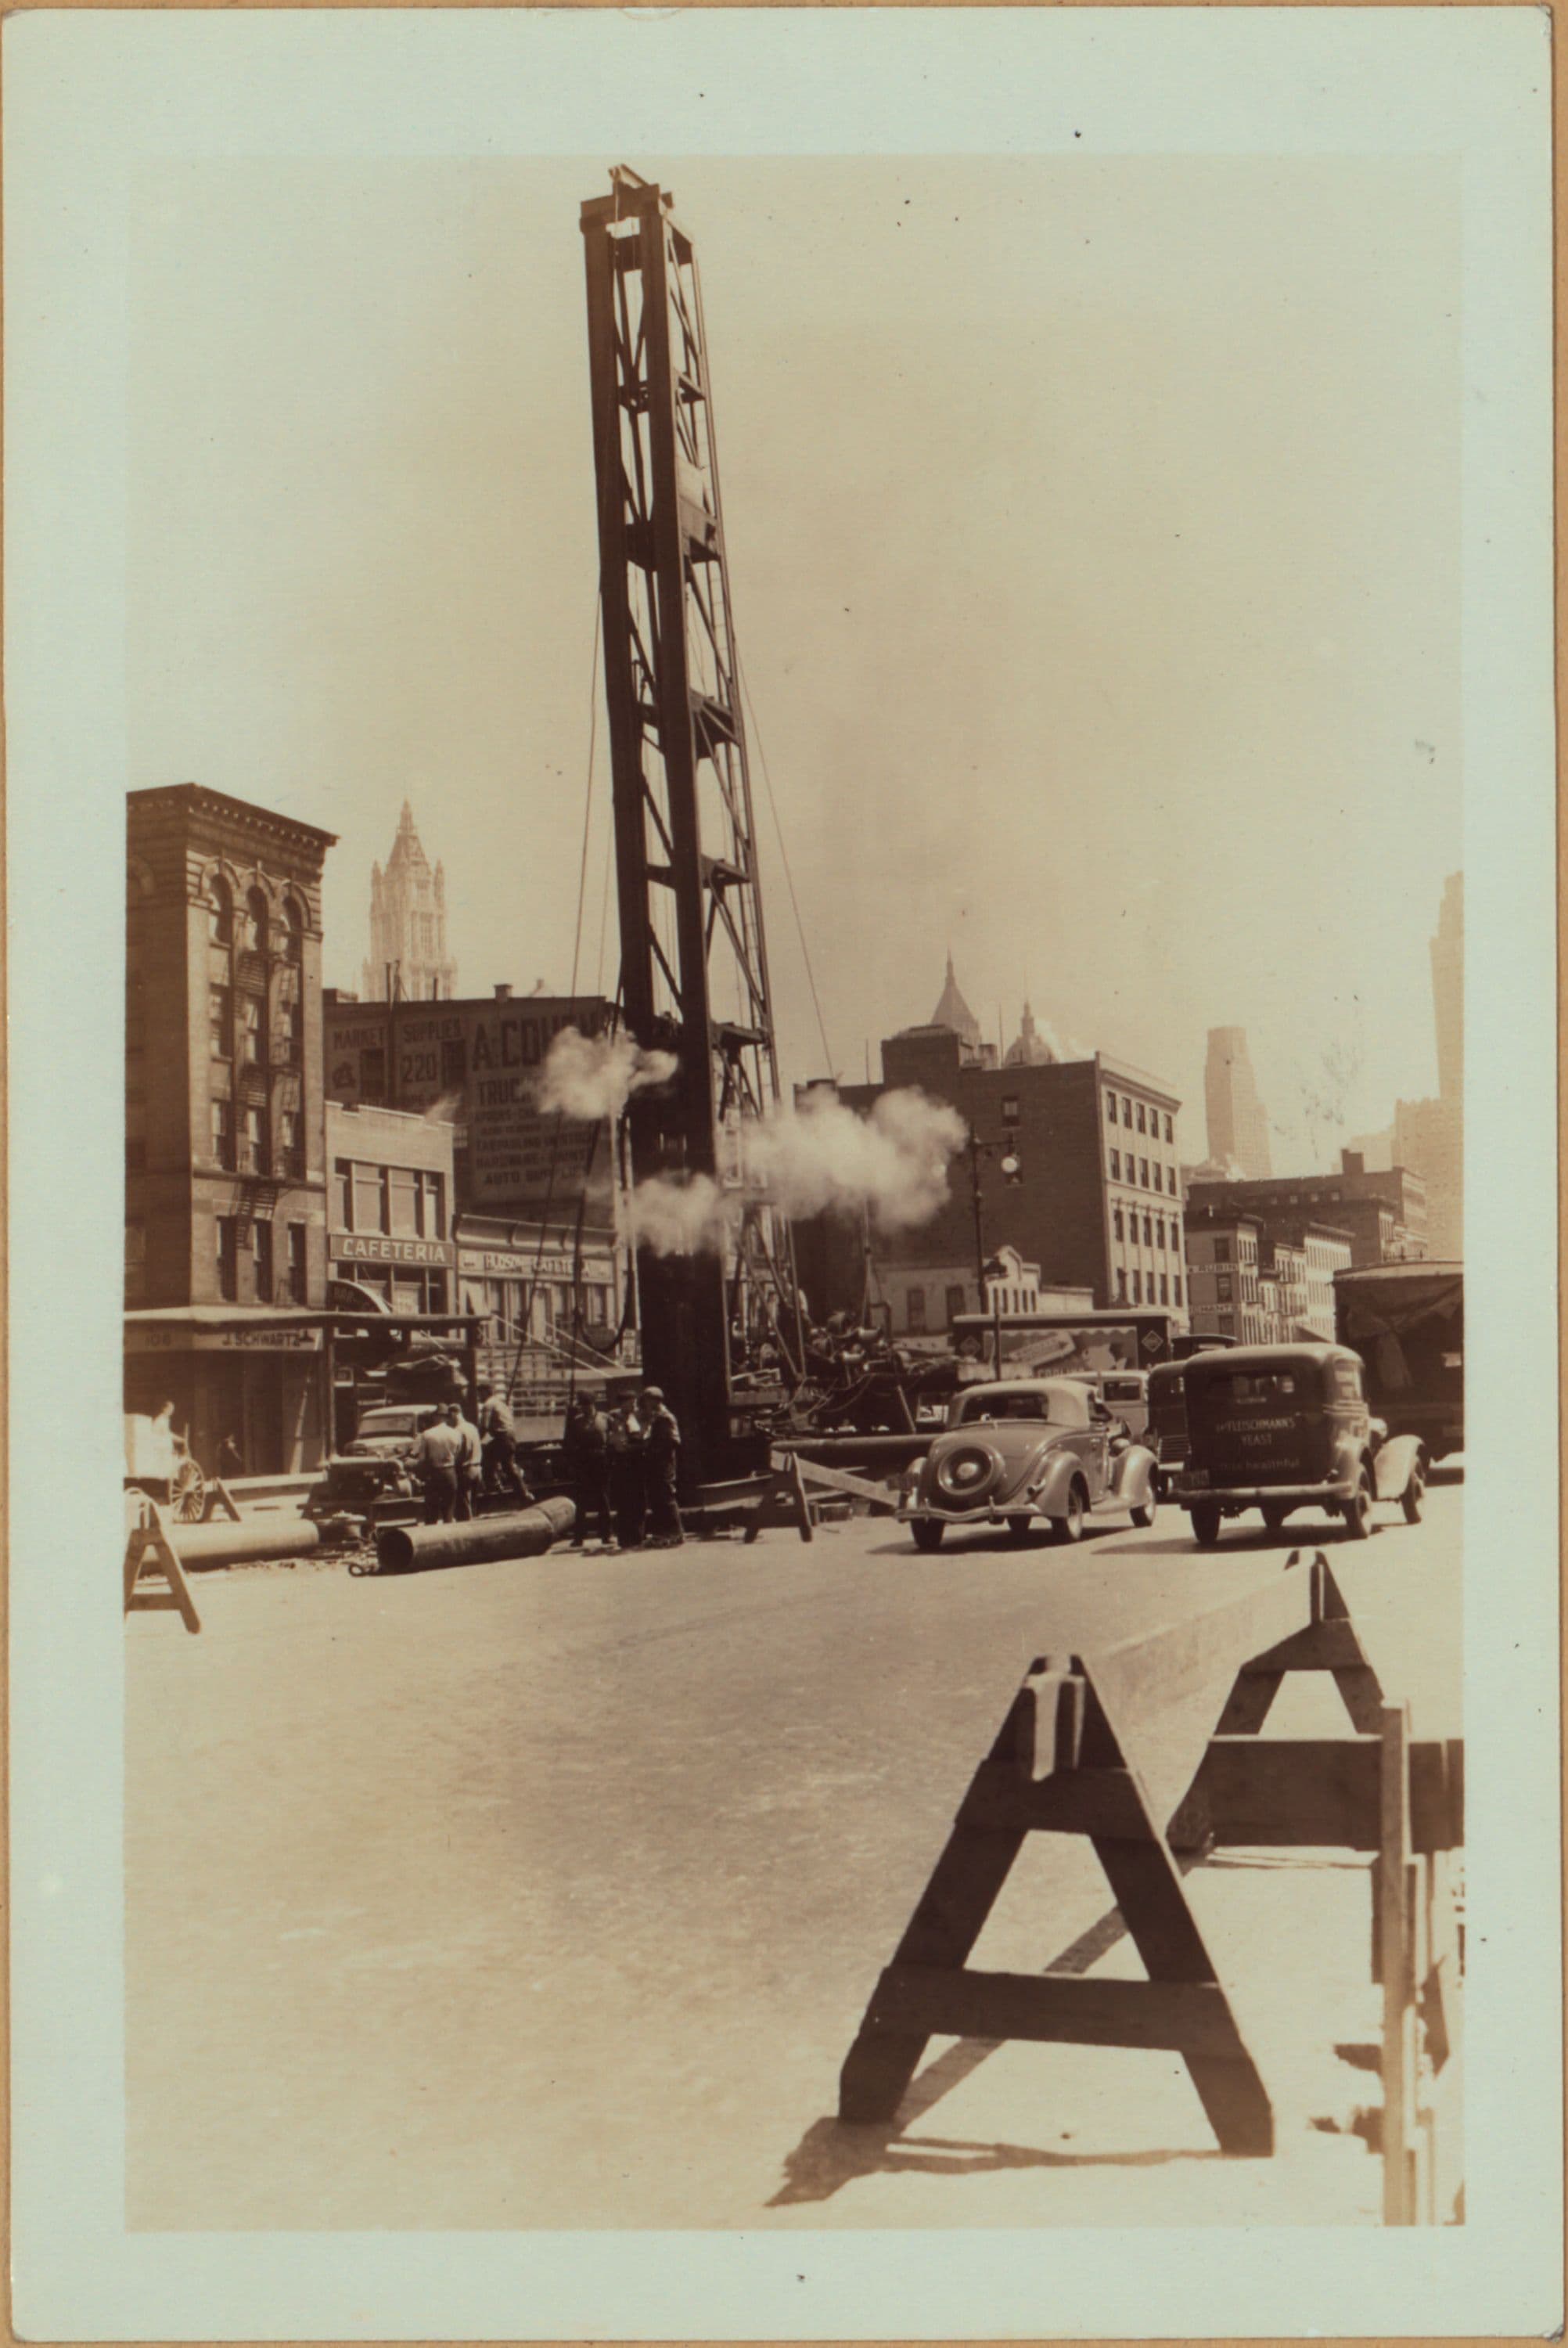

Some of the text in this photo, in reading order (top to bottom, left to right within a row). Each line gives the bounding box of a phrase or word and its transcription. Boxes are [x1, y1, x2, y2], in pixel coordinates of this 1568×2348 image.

[333, 1025, 385, 1050] MARKET
[401, 1053, 437, 1083] 220
[484, 1171, 520, 1186] AUTO
[342, 1239, 446, 1262] CAFETERIA
[484, 1254, 591, 1277] HUDSON CAFETEA
[1227, 1415, 1296, 1433] FLEISCHMANN'S
[1241, 1433, 1272, 1446] YEAST
